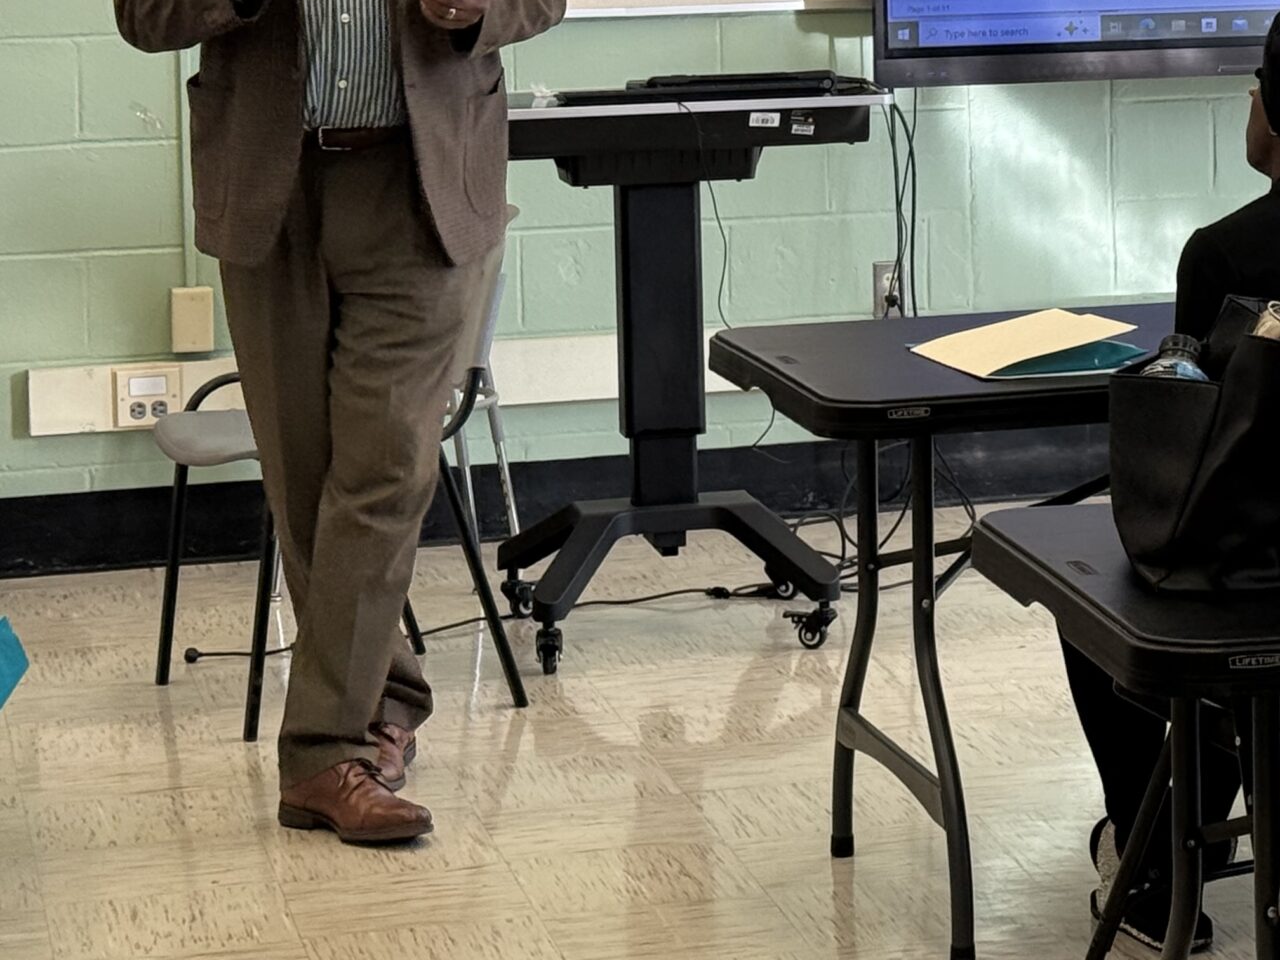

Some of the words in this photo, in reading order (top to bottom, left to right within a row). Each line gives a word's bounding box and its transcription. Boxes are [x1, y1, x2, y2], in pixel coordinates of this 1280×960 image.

[945, 29, 965, 39] Type
[968, 28, 987, 37] here
[989, 28, 998, 37] to
[1000, 27, 1029, 37] search
